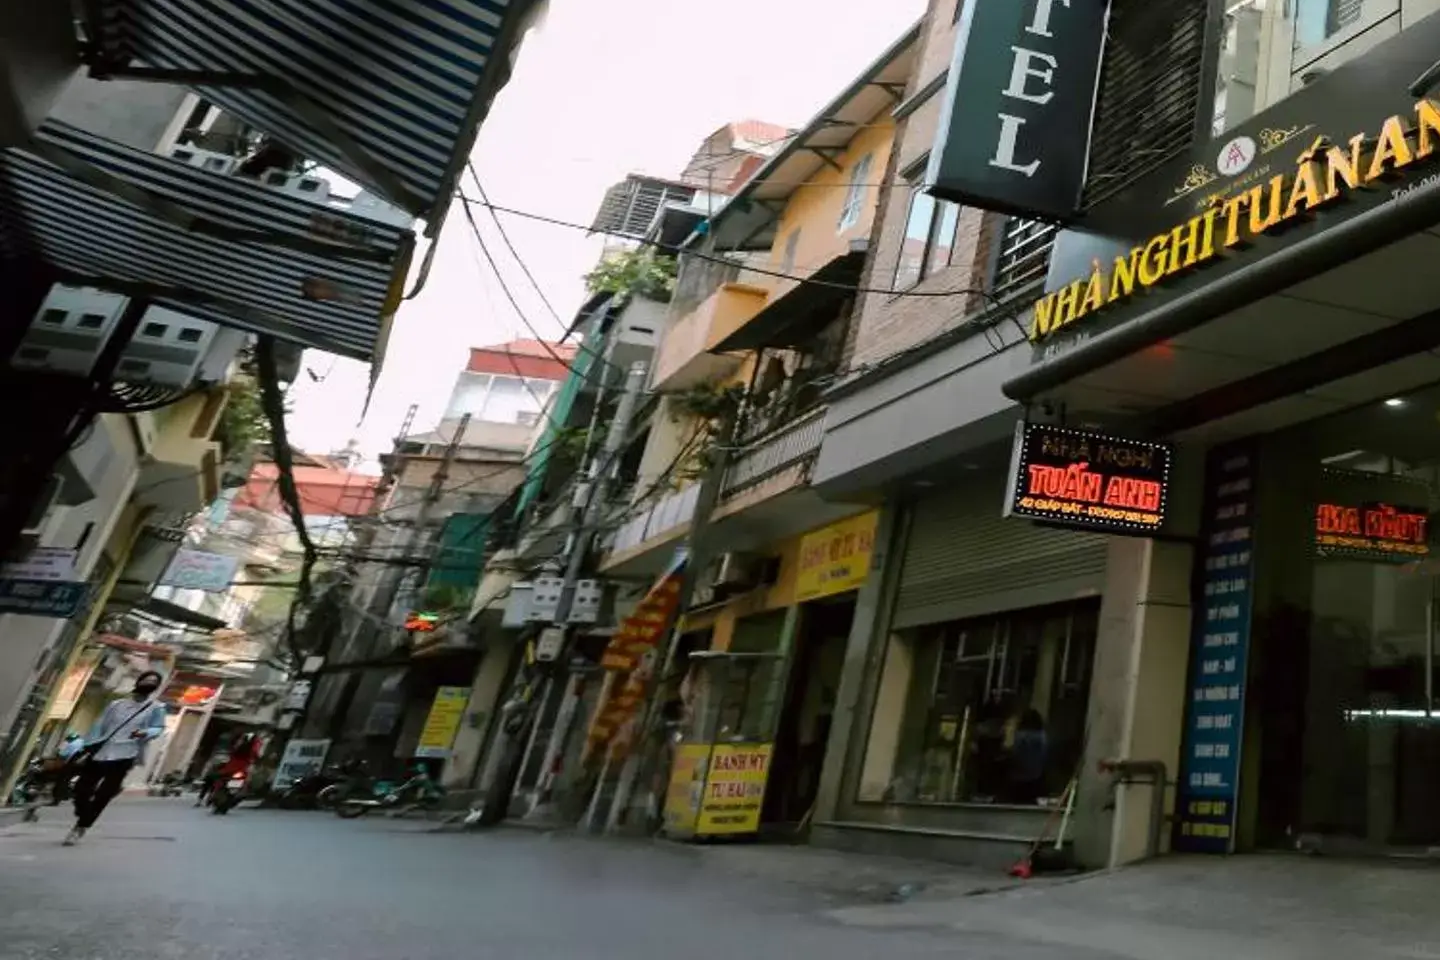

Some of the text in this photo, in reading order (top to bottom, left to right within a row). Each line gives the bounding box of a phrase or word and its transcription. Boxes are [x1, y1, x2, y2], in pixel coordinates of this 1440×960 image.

[1028, 258, 1105, 343] NHÀ
[1219, 132, 1365, 249] TUẤN
[1028, 461, 1162, 511] TUẤN ANH
